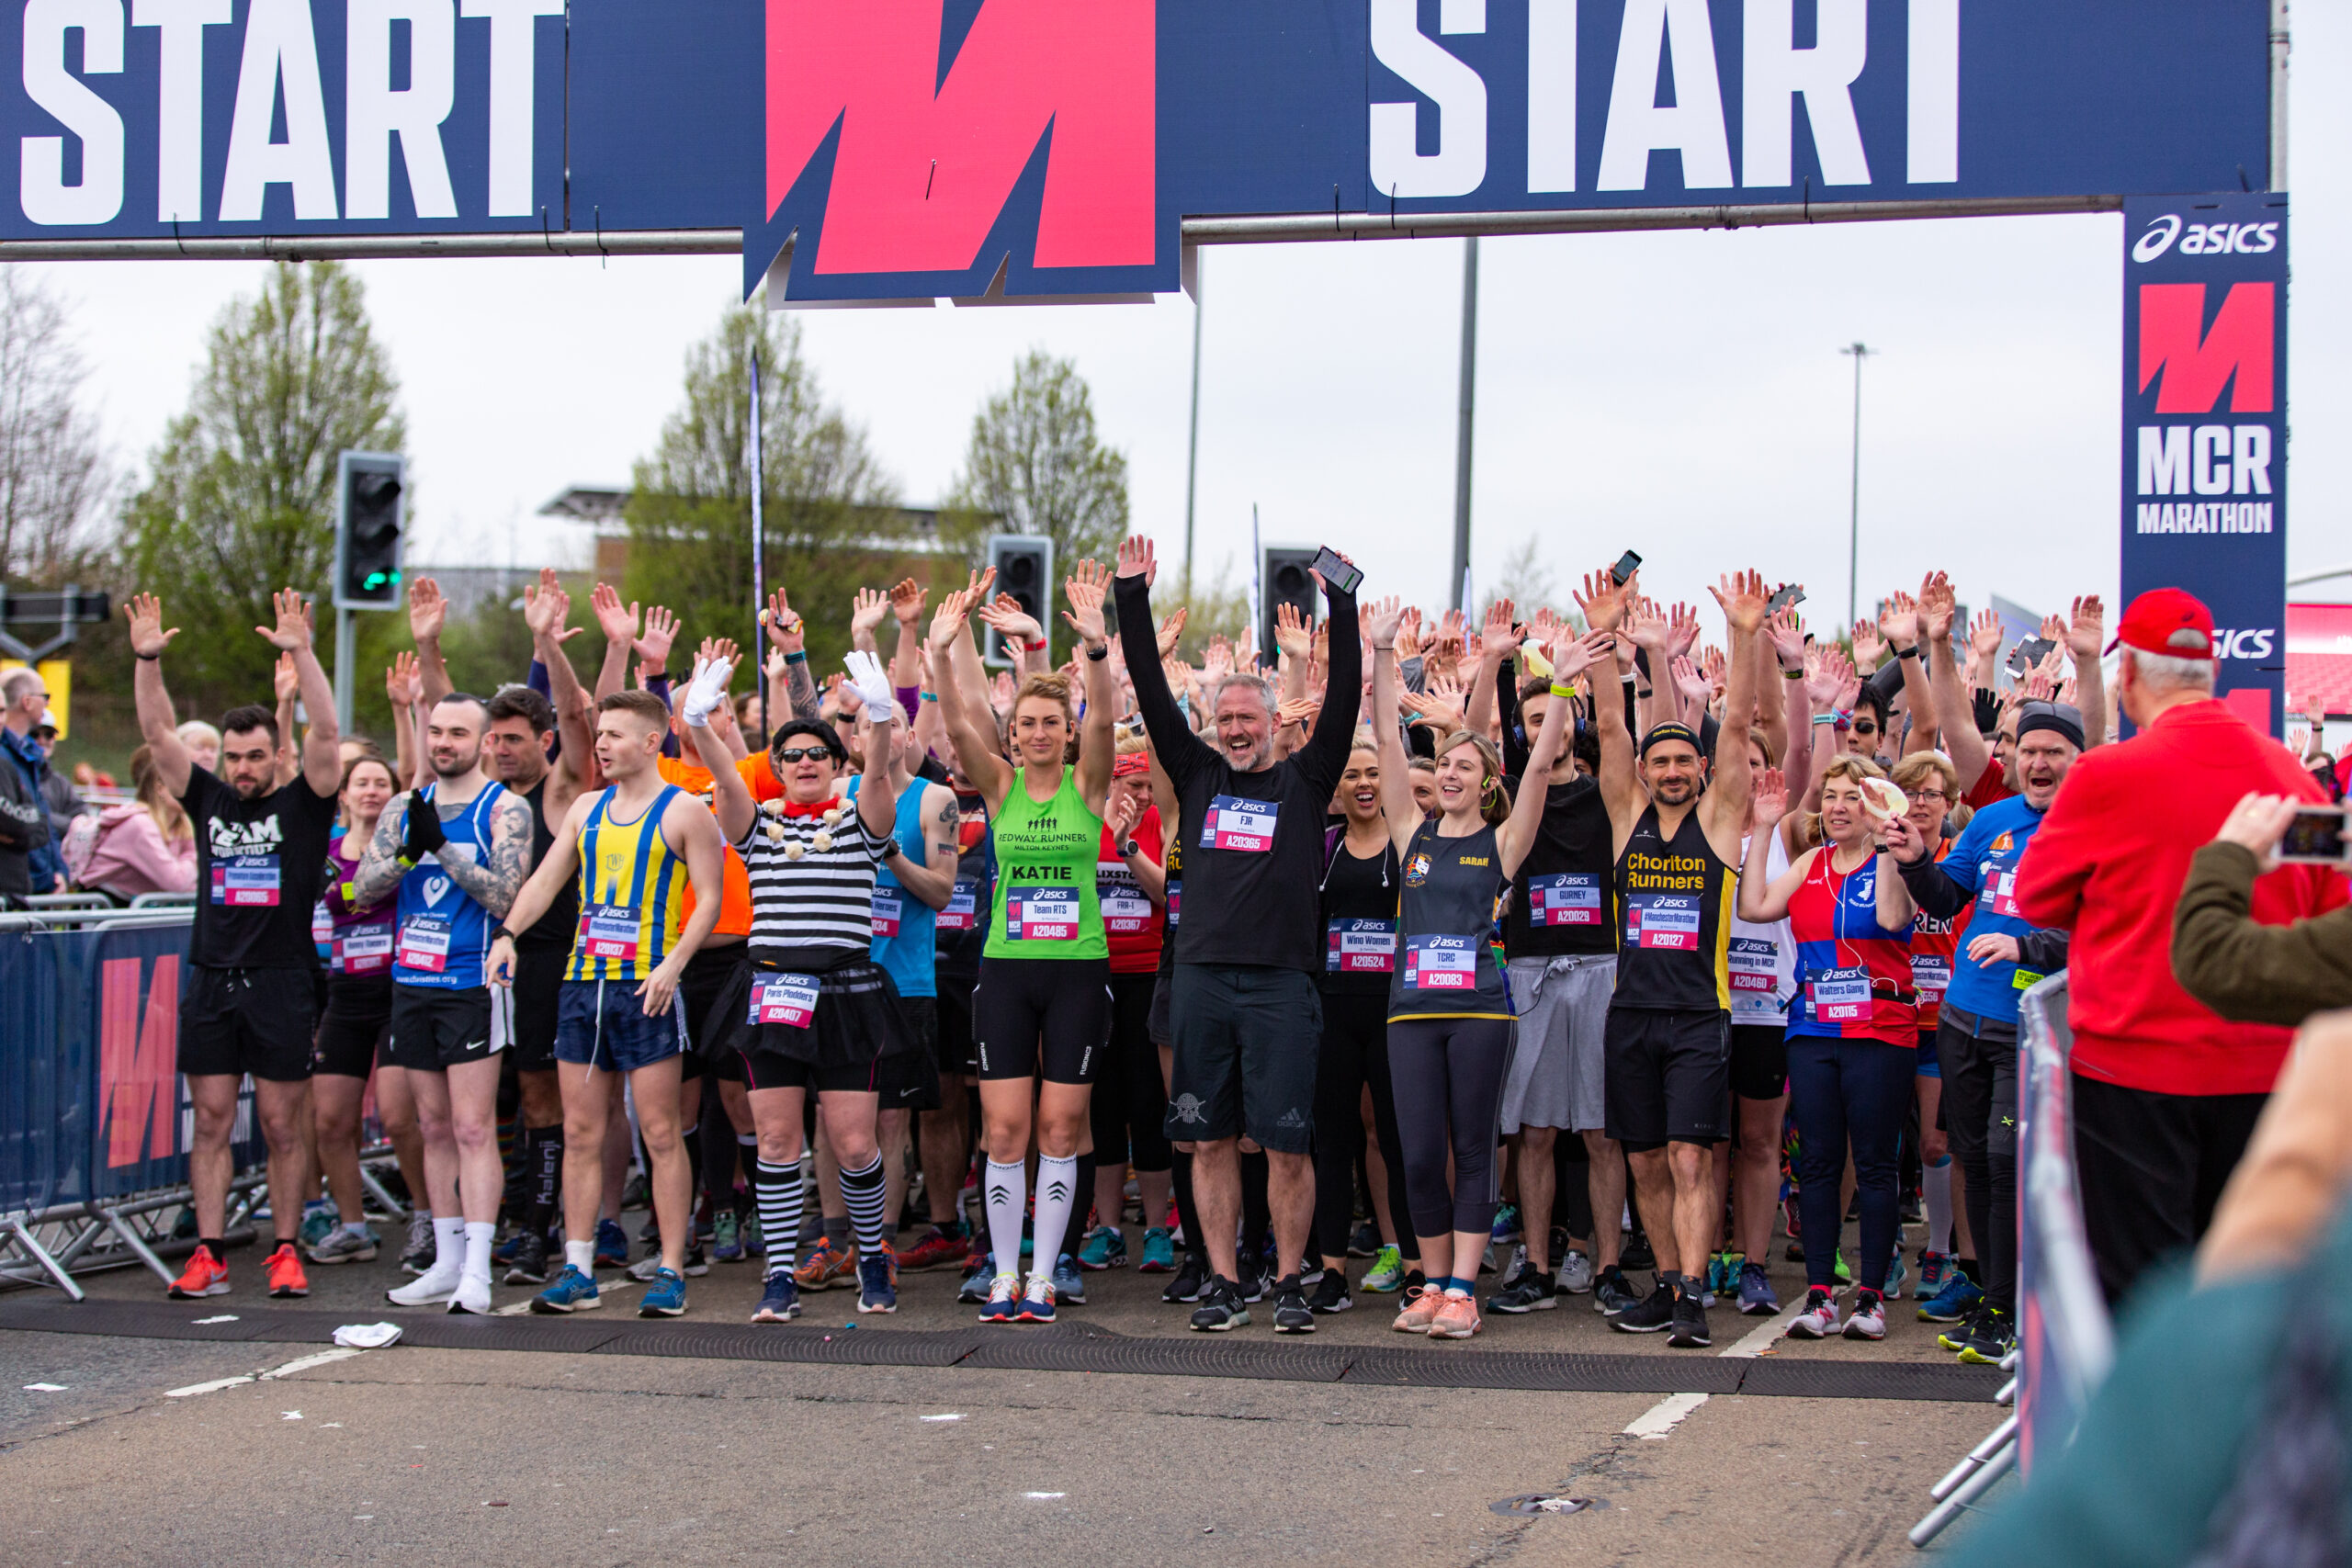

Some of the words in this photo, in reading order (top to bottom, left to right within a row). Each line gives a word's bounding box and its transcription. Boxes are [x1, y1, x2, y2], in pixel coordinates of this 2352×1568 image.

[20, 0, 564, 225] START
[2179, 221, 2278, 254] asics
[2137, 425, 2272, 495] MCR
[2137, 502, 2273, 534] MARATHON
[1242, 803, 1266, 813] asics
[1240, 816, 1253, 826] FJR
[999, 834, 1037, 842] REDWAY
[1041, 833, 1087, 842] RUNNERS
[1226, 835, 1261, 849] A20365
[1459, 856, 1489, 867] SARAH
[1628, 852, 1706, 872] Chorlton
[1012, 866, 1072, 880] KATIE
[1566, 877, 1589, 886] asics
[1627, 872, 1704, 889] Runners
[1045, 890, 1068, 899] asics
[1559, 890, 1587, 900] GURNEY
[1664, 898, 1688, 908] asics
[1034, 905, 1052, 914] Team
[1053, 905, 1067, 914] RTS
[1557, 910, 1590, 922] A20029
[1033, 925, 1068, 937] A20485
[1363, 921, 1385, 931] asics
[1347, 935, 1364, 945] Wino
[1365, 935, 1391, 946] Women
[1440, 939, 1464, 948] asics
[1652, 933, 1684, 946] A20127
[1747, 942, 1770, 953] asics
[1351, 955, 1385, 968] A20524
[1437, 953, 1456, 963] TCRC
[1728, 953, 1754, 967] Running
[1761, 957, 1775, 968] MCR
[1428, 974, 1463, 986] A20083
[1833, 969, 1857, 979] asics
[786, 976, 809, 986] asics
[1734, 975, 1768, 989] A20460
[766, 988, 783, 998] Paris
[783, 989, 813, 1002] Plodders
[1818, 985, 1845, 995] Walters
[1846, 983, 1864, 995] Gang
[767, 1007, 802, 1022] A20407
[1828, 1004, 1858, 1018] A20115
[537, 1141, 561, 1204] Kalenji
